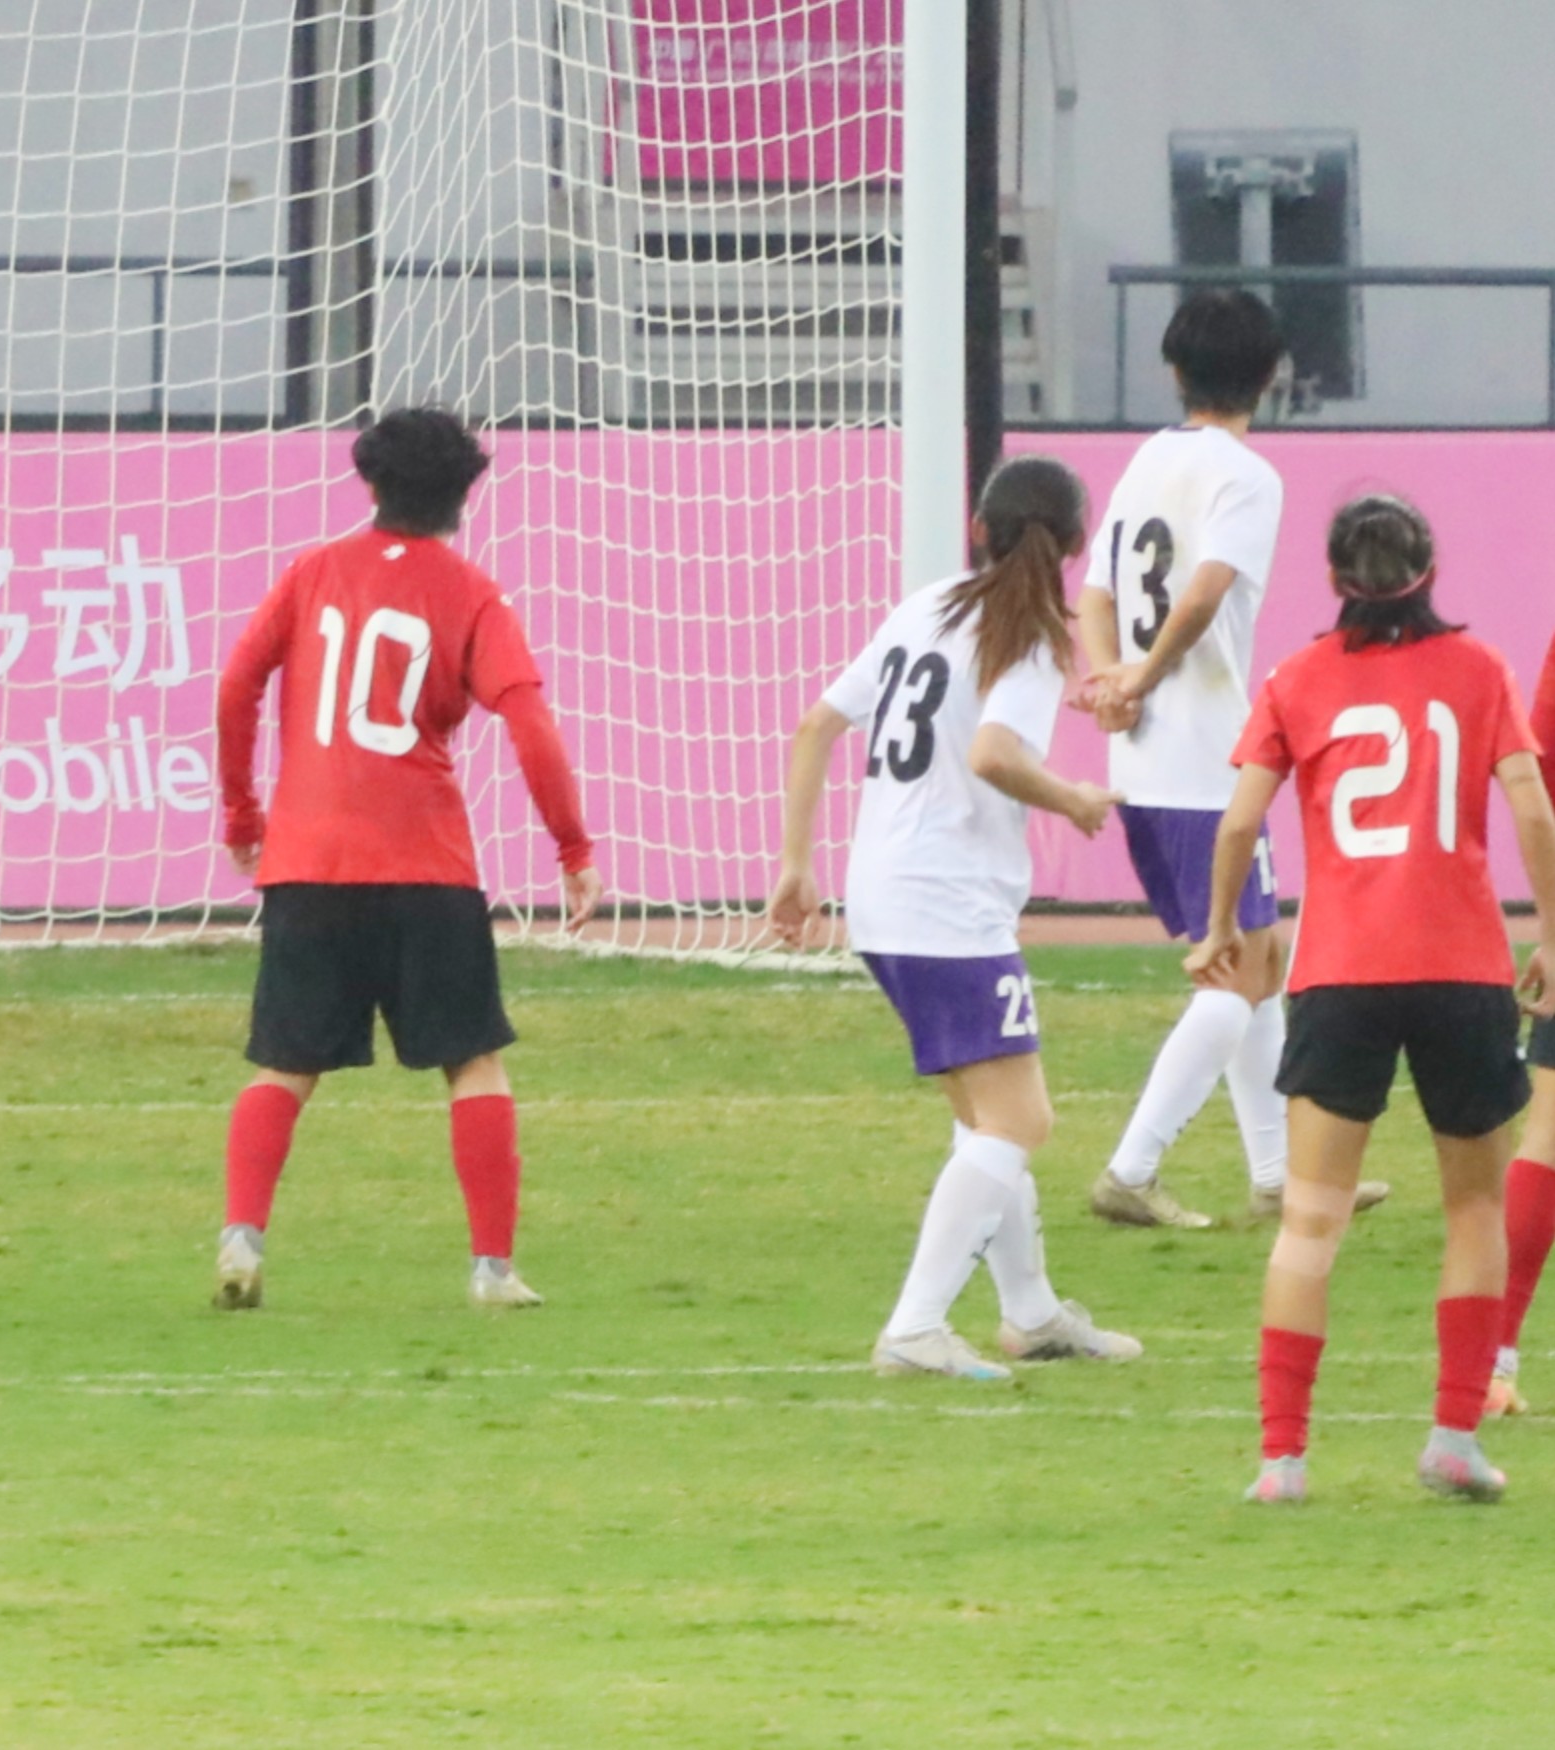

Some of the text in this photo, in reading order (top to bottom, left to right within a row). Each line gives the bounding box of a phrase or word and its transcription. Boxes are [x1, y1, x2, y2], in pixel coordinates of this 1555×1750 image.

[1110, 517, 1174, 657] 13
[315, 605, 432, 757] 10
[866, 646, 950, 783] 23
[1329, 699, 1460, 858] 21
